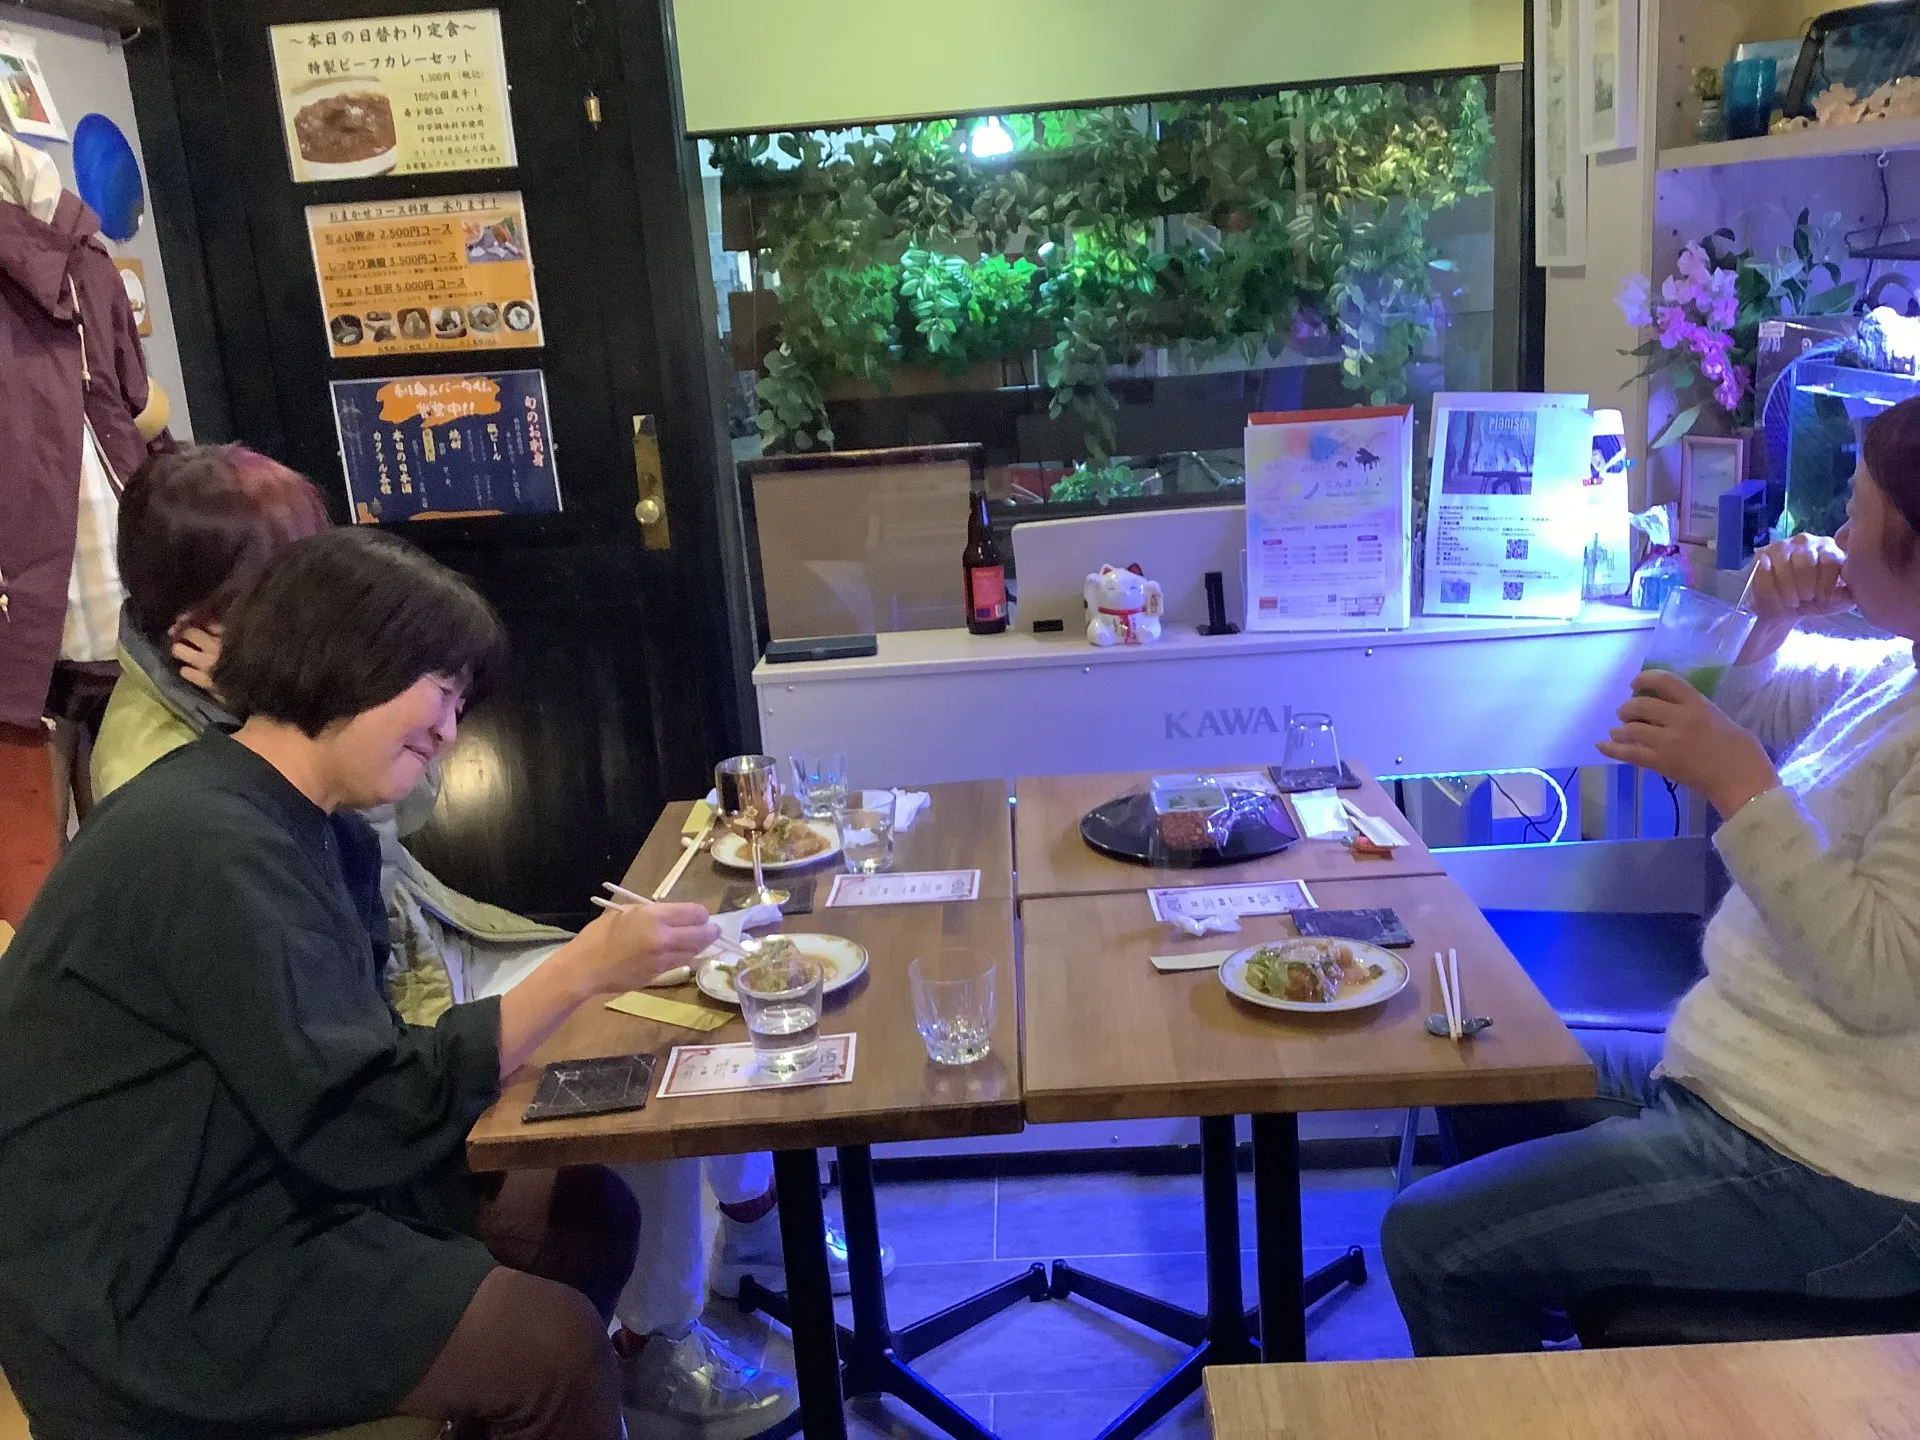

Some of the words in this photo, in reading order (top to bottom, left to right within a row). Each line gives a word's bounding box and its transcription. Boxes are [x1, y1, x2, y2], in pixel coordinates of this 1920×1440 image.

[307, 49, 473, 75] 特製ビーフカレーセット
[329, 202, 430, 222] おまかせコース料理
[325, 230, 375, 245] ちょい飲み
[437, 277, 467, 290] コース
[1163, 704, 1293, 740] KAWAI
